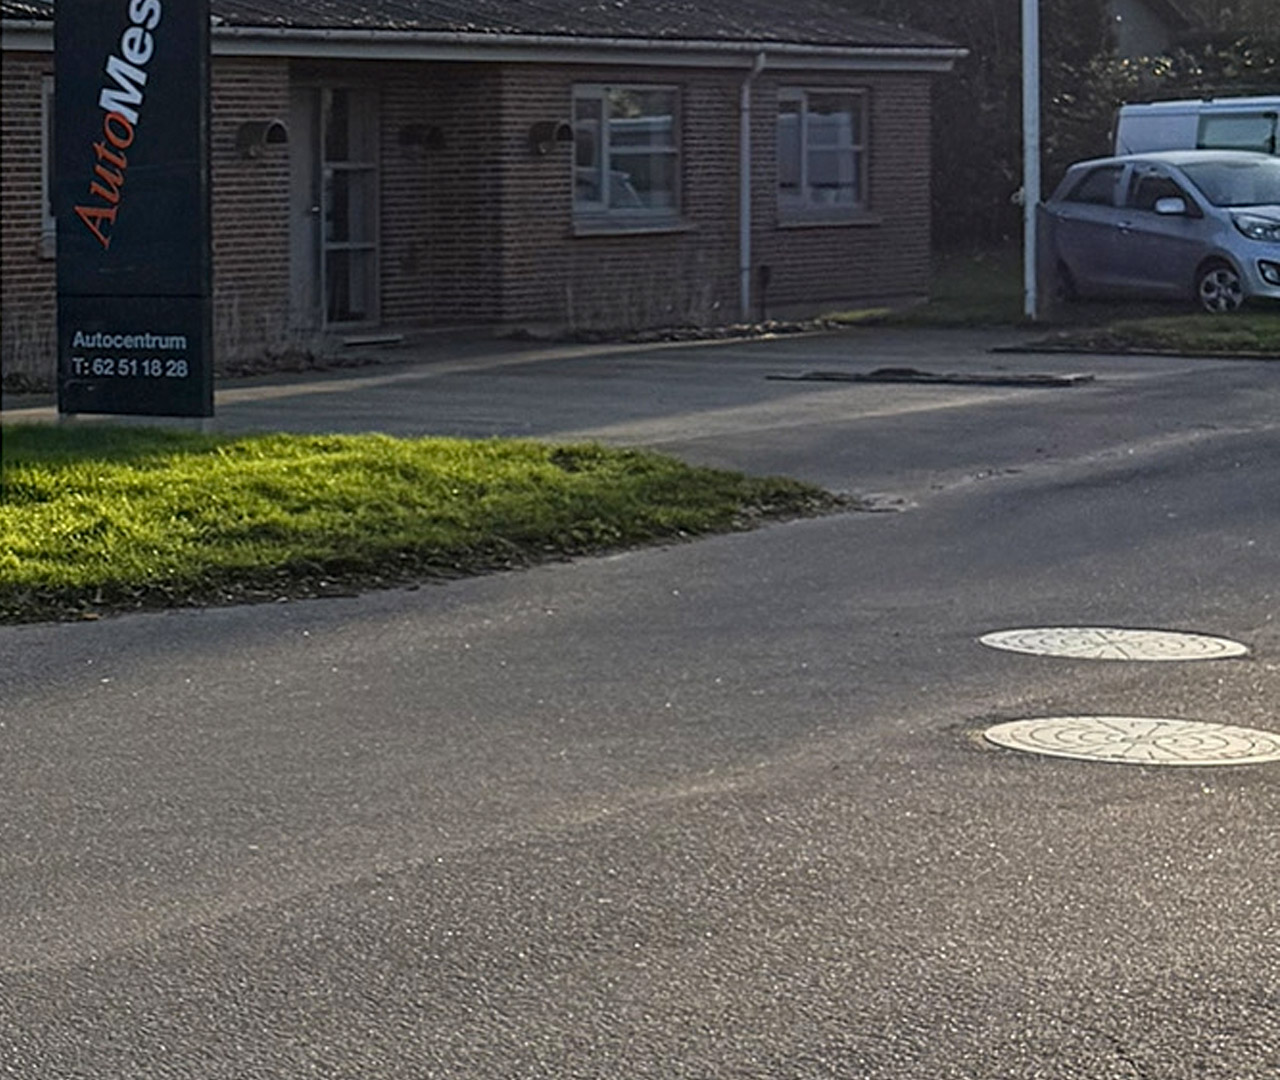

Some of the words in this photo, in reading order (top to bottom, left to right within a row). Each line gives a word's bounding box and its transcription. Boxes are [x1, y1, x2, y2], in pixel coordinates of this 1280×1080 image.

[73, 331, 186, 349] Autocentrum
[72, 358, 89, 375] T:
[92, 358, 115, 376] 62
[118, 359, 138, 377] 51
[141, 359, 162, 378] 18
[165, 359, 189, 378] 28
